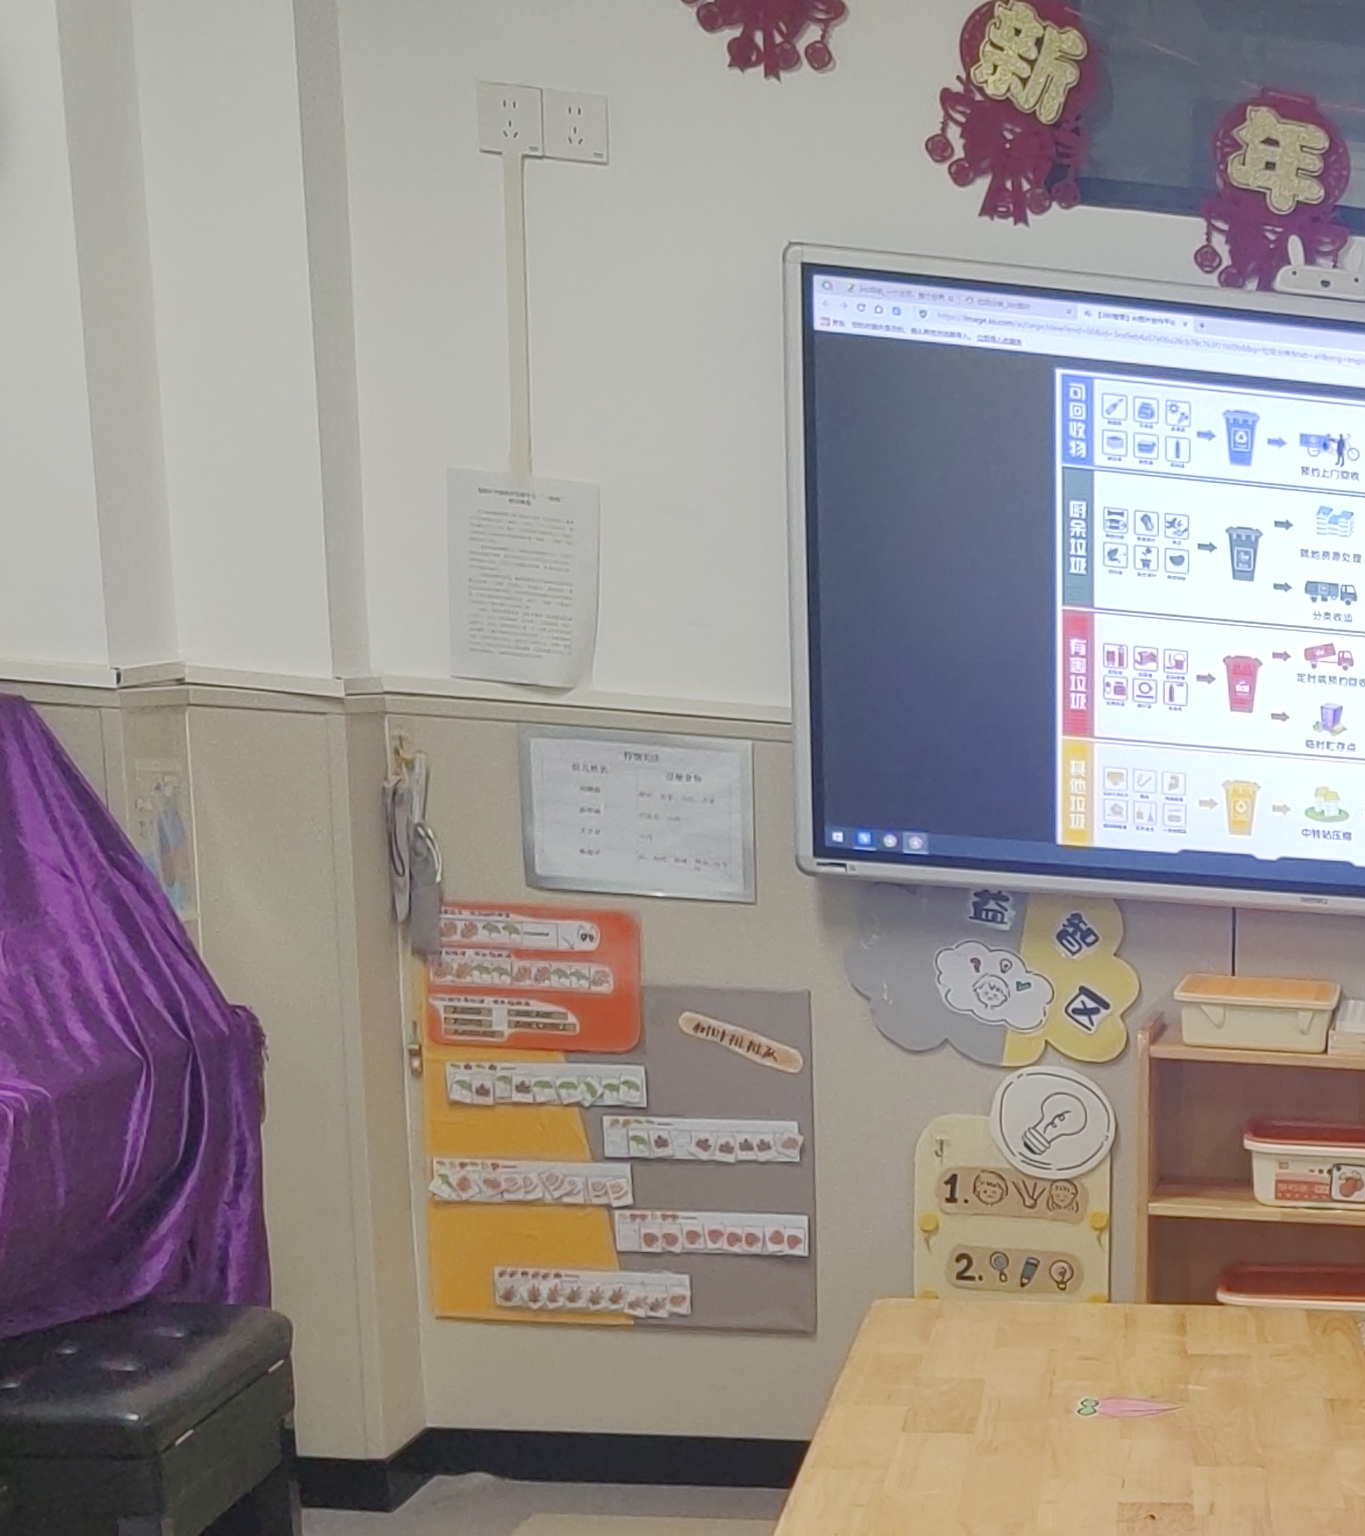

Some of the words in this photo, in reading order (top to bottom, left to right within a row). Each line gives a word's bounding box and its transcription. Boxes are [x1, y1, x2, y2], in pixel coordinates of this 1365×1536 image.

[1069, 383, 1086, 458] 可回收物
[1300, 466, 1360, 482] 预约上门回收
[1069, 501, 1087, 575] 厨余垃圾
[1070, 639, 1087, 710] 有害垃圾
[1070, 760, 1087, 830] 其他垃圾
[943, 1173, 969, 1204] 1.
[955, 1253, 983, 1282] 2.
